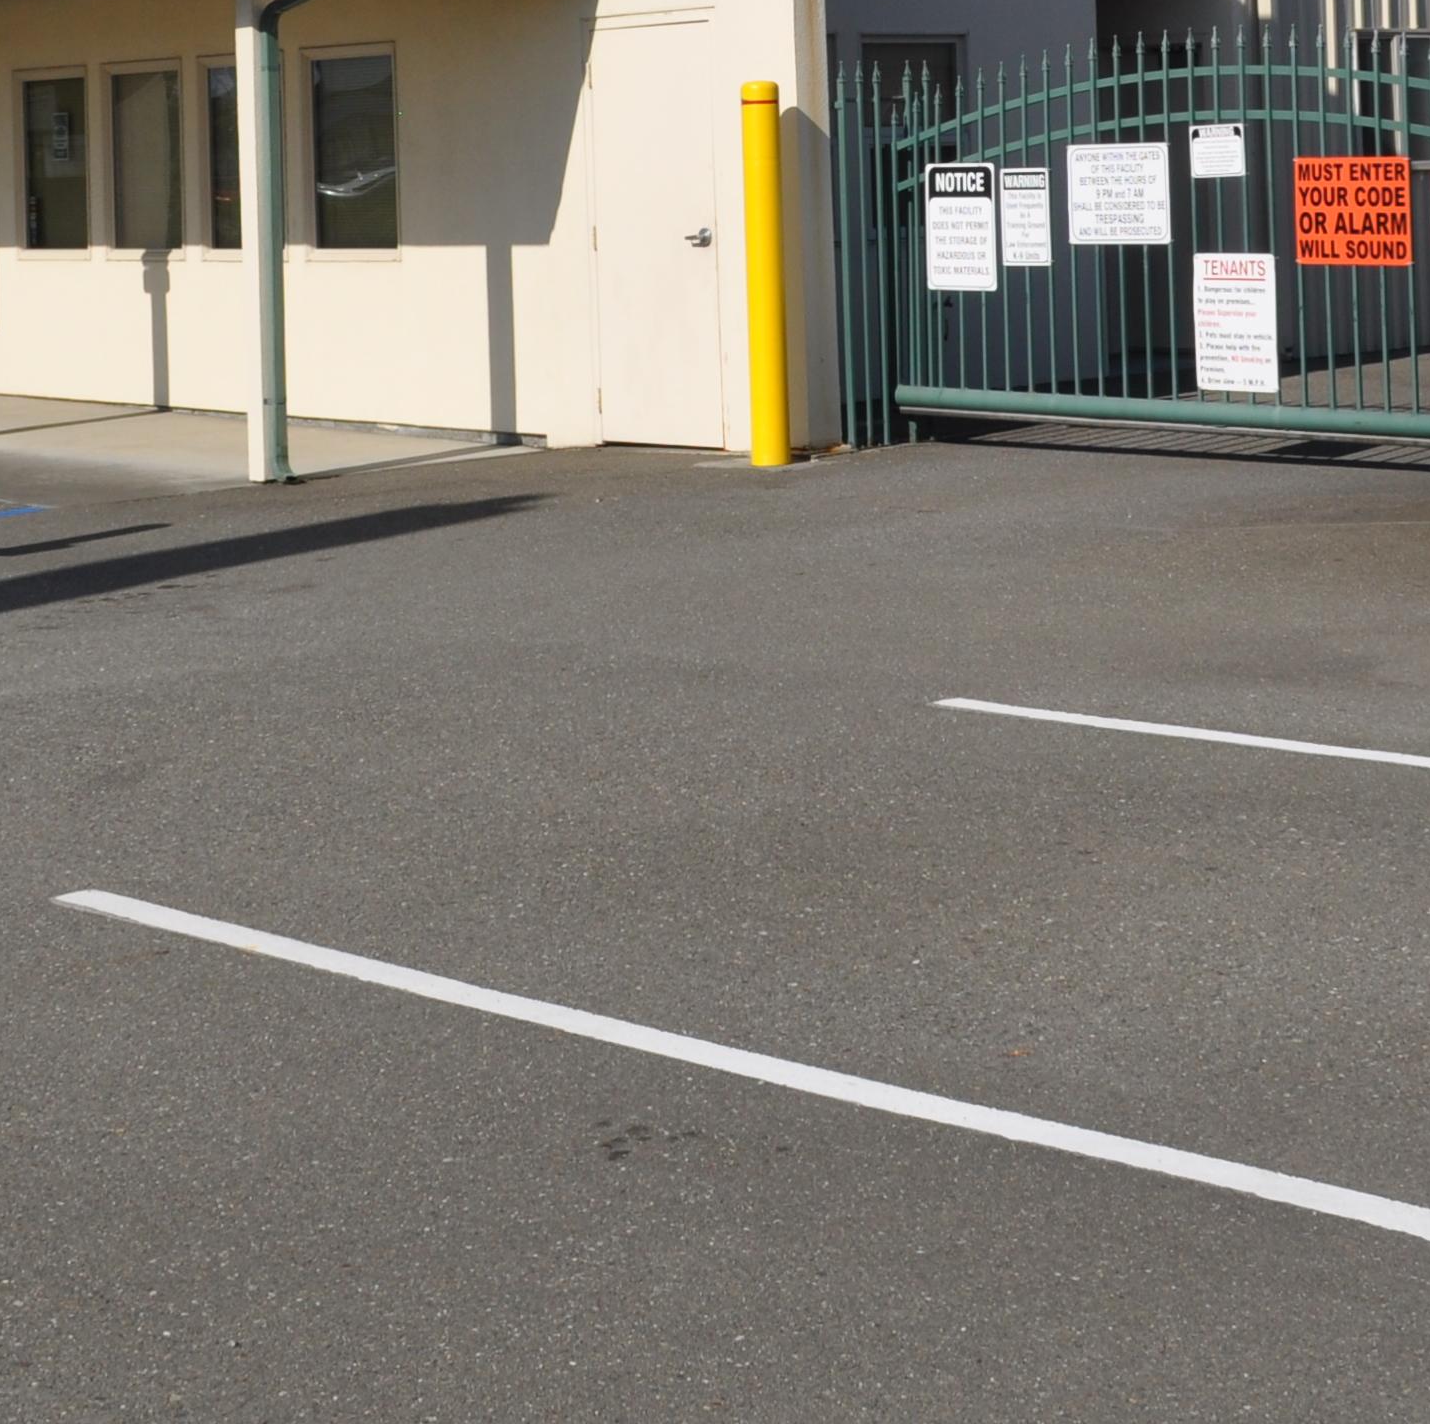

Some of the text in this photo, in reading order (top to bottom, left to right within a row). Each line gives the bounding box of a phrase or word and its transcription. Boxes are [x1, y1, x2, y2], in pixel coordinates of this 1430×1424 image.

[1004, 175, 1045, 187] WARNING
[1298, 163, 1406, 181] MUST ENTER
[935, 172, 985, 192] NOTICE
[1299, 187, 1406, 207] YOUR CODE
[1095, 214, 1144, 224] TRESPASSING
[1299, 212, 1407, 235] OR ALARM
[1300, 240, 1407, 260] WILL SOUND
[1203, 260, 1266, 276] TENANTS
